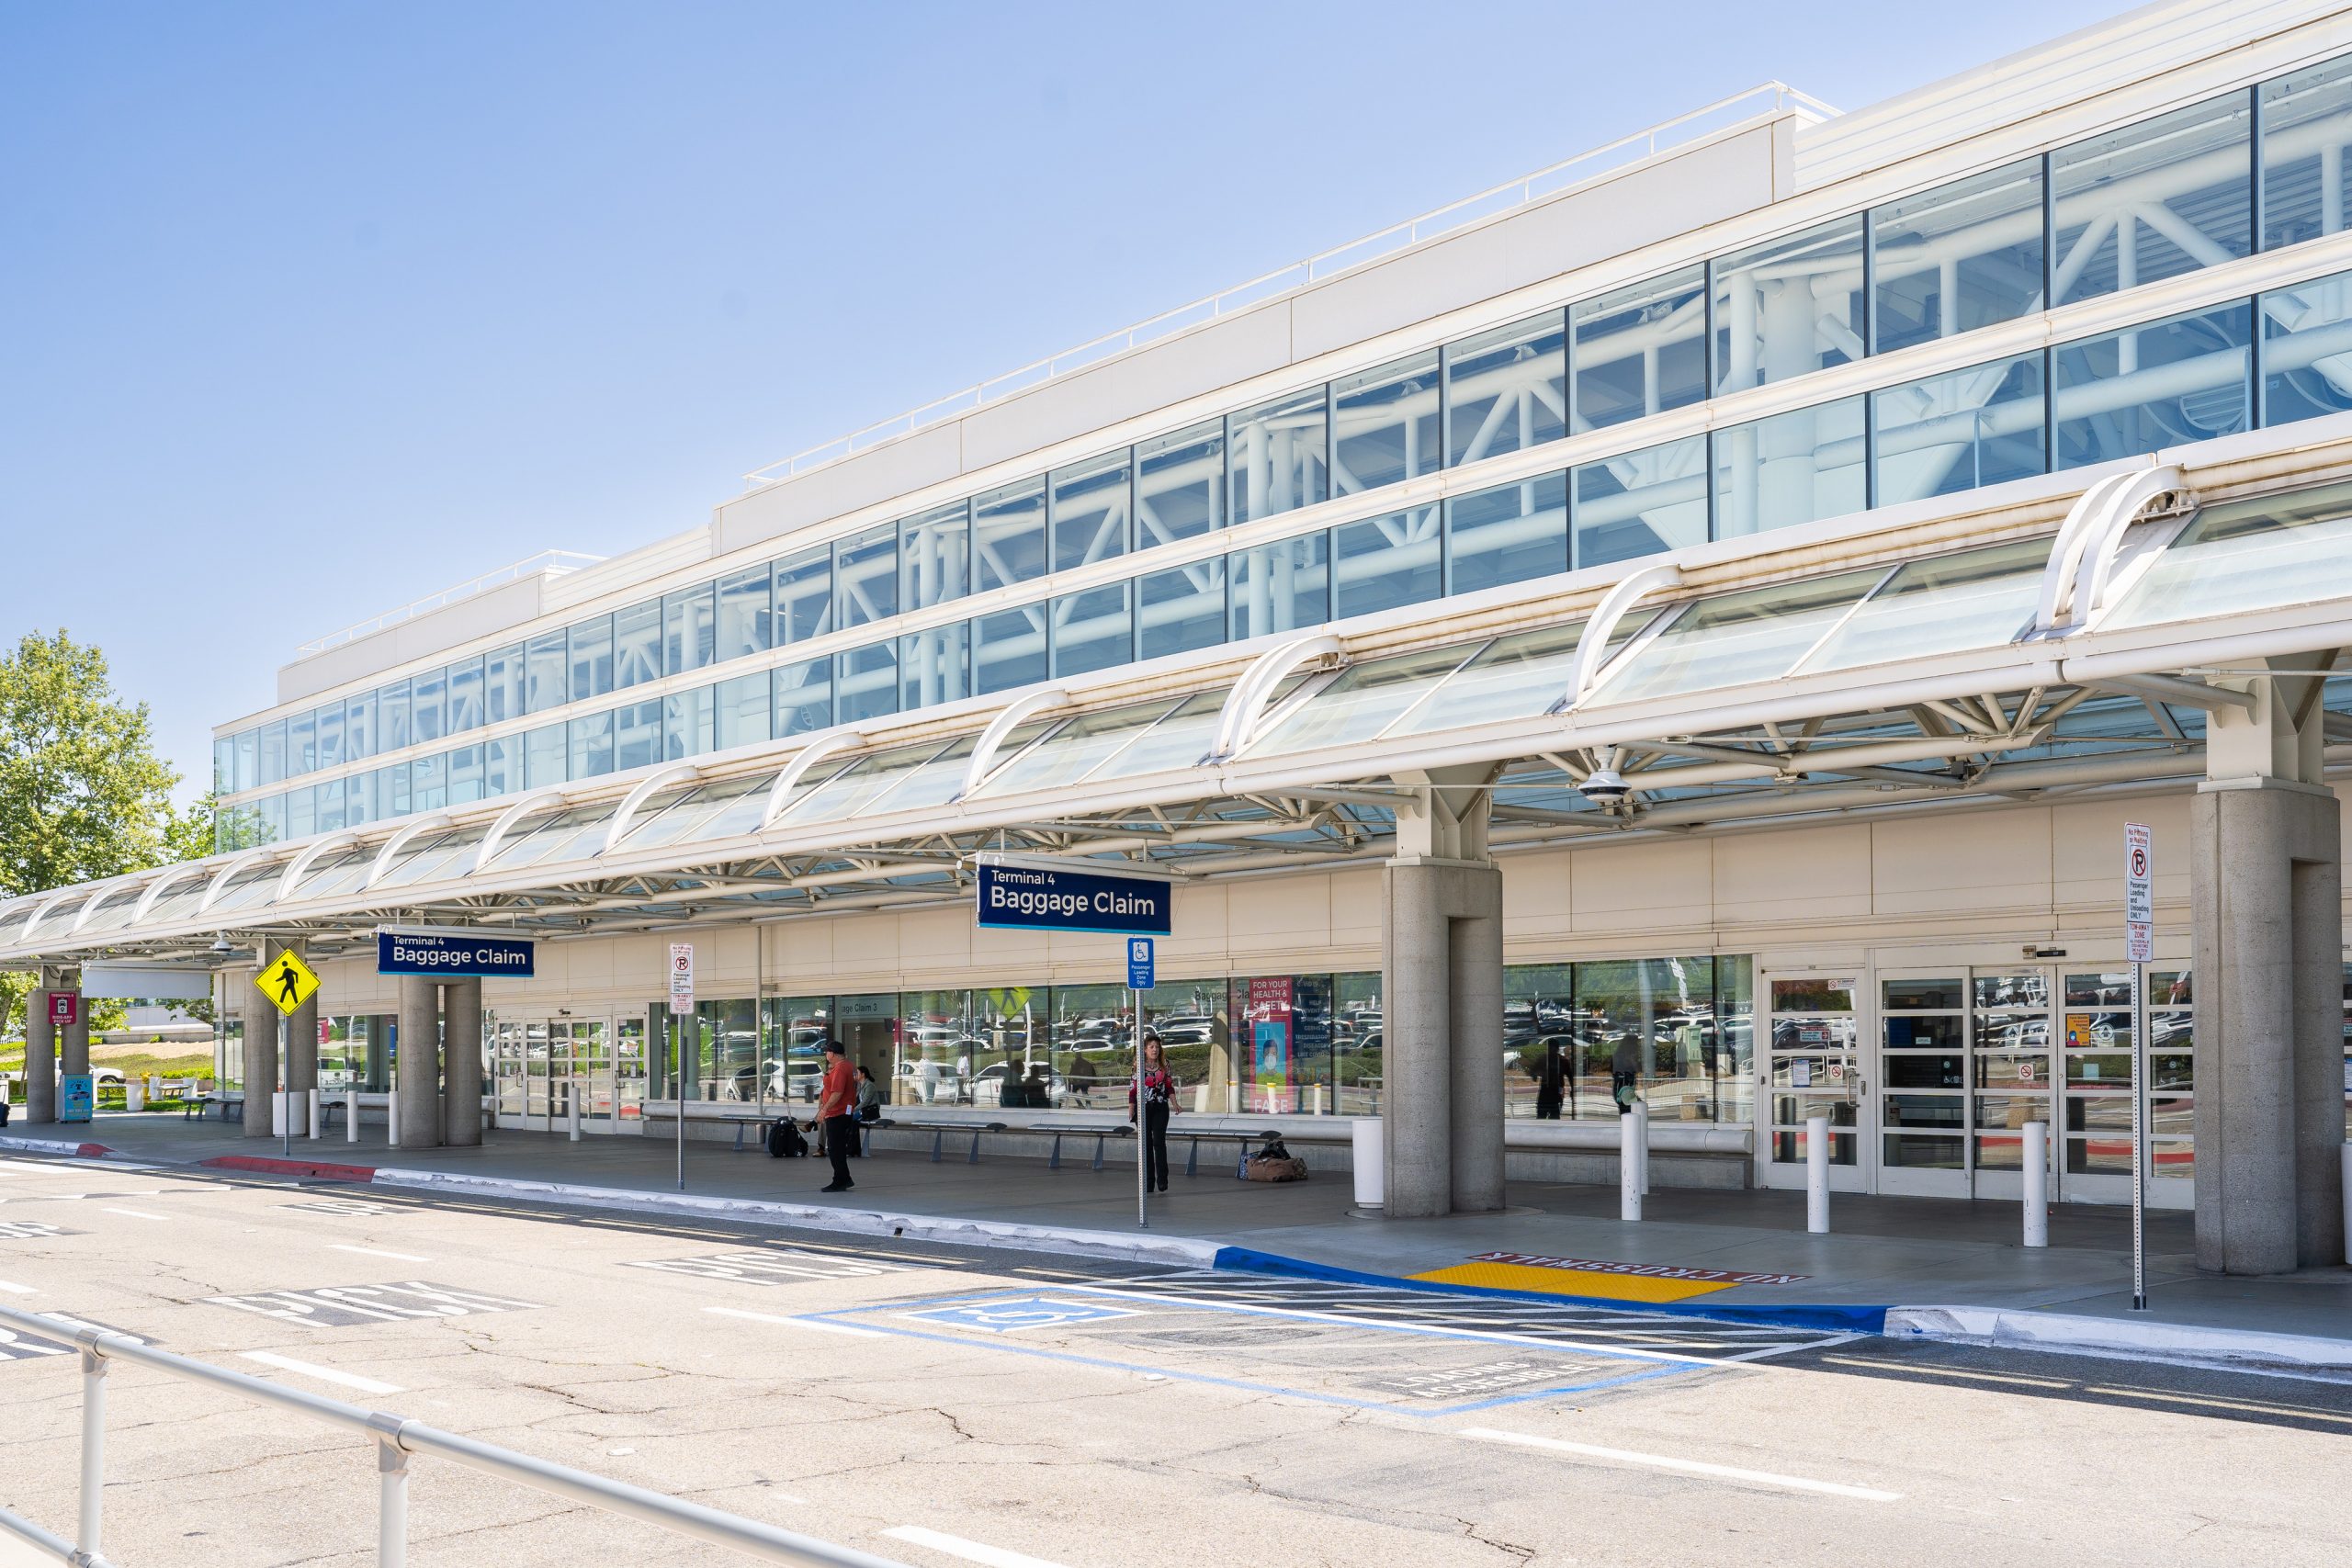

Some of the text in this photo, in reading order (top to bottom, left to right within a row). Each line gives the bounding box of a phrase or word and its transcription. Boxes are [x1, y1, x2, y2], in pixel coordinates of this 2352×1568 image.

[2133, 829, 2149, 839] Parking
[2133, 837, 2148, 845] Waiting
[991, 870, 1056, 886] Terminal 4
[2130, 881, 2149, 891] Passenger
[2130, 889, 2145, 898] Loading
[990, 886, 1155, 916] Baggage Claim
[2130, 905, 2150, 914] Unloading
[393, 936, 445, 946] Terminal 4
[393, 946, 526, 965] Baggage Claim
[1252, 980, 1288, 989] FOR YOUR
[1195, 991, 1227, 1002] Baggag
[1253, 989, 1287, 998] HEALTH &
[854, 1002, 872, 1012] Claim
[873, 1003, 878, 1011] 3
[1254, 1099, 1288, 1113] FACE
[1477, 1251, 1804, 1284] NO CROSSWALK
[202, 1280, 548, 1328] PICK
[1381, 1360, 1532, 1388] LOADING
